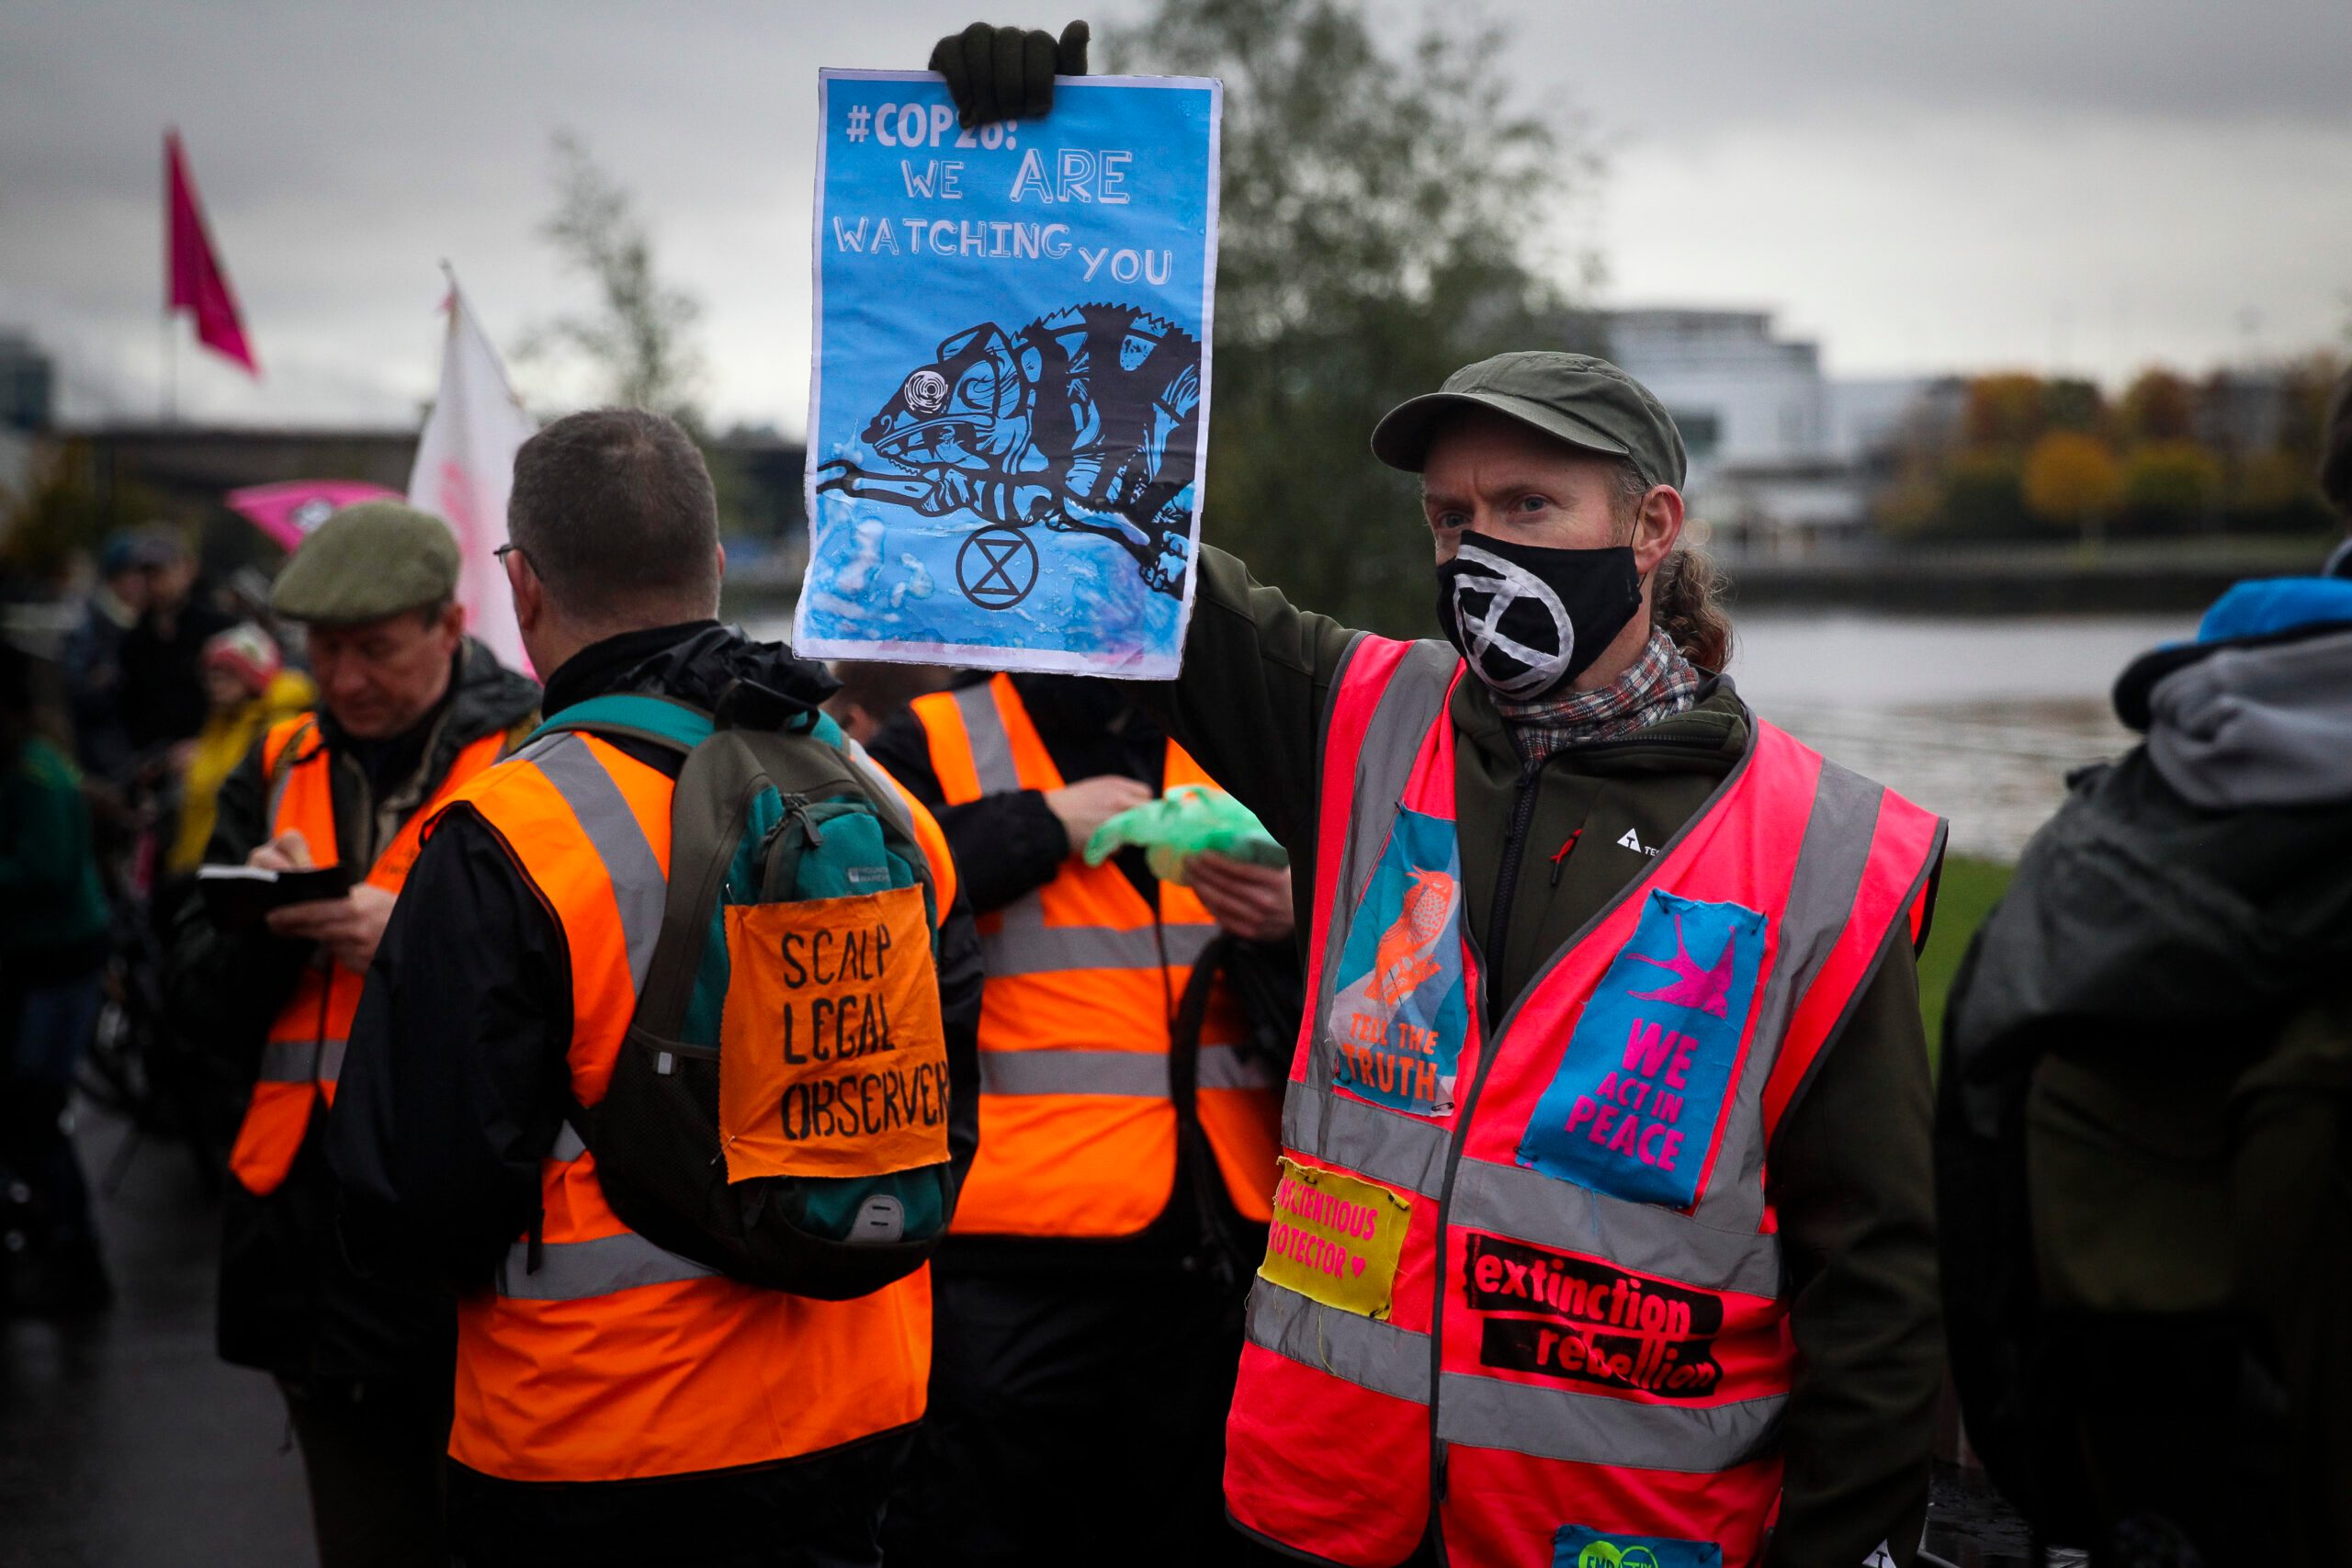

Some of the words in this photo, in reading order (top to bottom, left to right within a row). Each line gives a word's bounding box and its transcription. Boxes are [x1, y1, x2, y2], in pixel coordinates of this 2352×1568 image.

[901, 160, 964, 199] WE
[1010, 149, 1133, 204] ARE
[833, 216, 1073, 260] WATCHING
[1079, 248, 1172, 285] YOU
[781, 923, 891, 988] SCALP
[784, 993, 896, 1065] LEGAL
[1349, 1012, 1388, 1044] TELL
[1398, 1022, 1440, 1055] THE
[1622, 1018, 1699, 1090] WE
[781, 1060, 949, 1141] OBSERVER
[1342, 1043, 1439, 1102] TRUTH
[1595, 1072, 1651, 1111] ACT
[1650, 1090, 1684, 1123] IN
[1564, 1094, 1685, 1172] PEACE
[1269, 1219, 1347, 1279] ROTECTOR
[1475, 1253, 1691, 1335] extinction
[1536, 1328, 1715, 1389] rebellion
